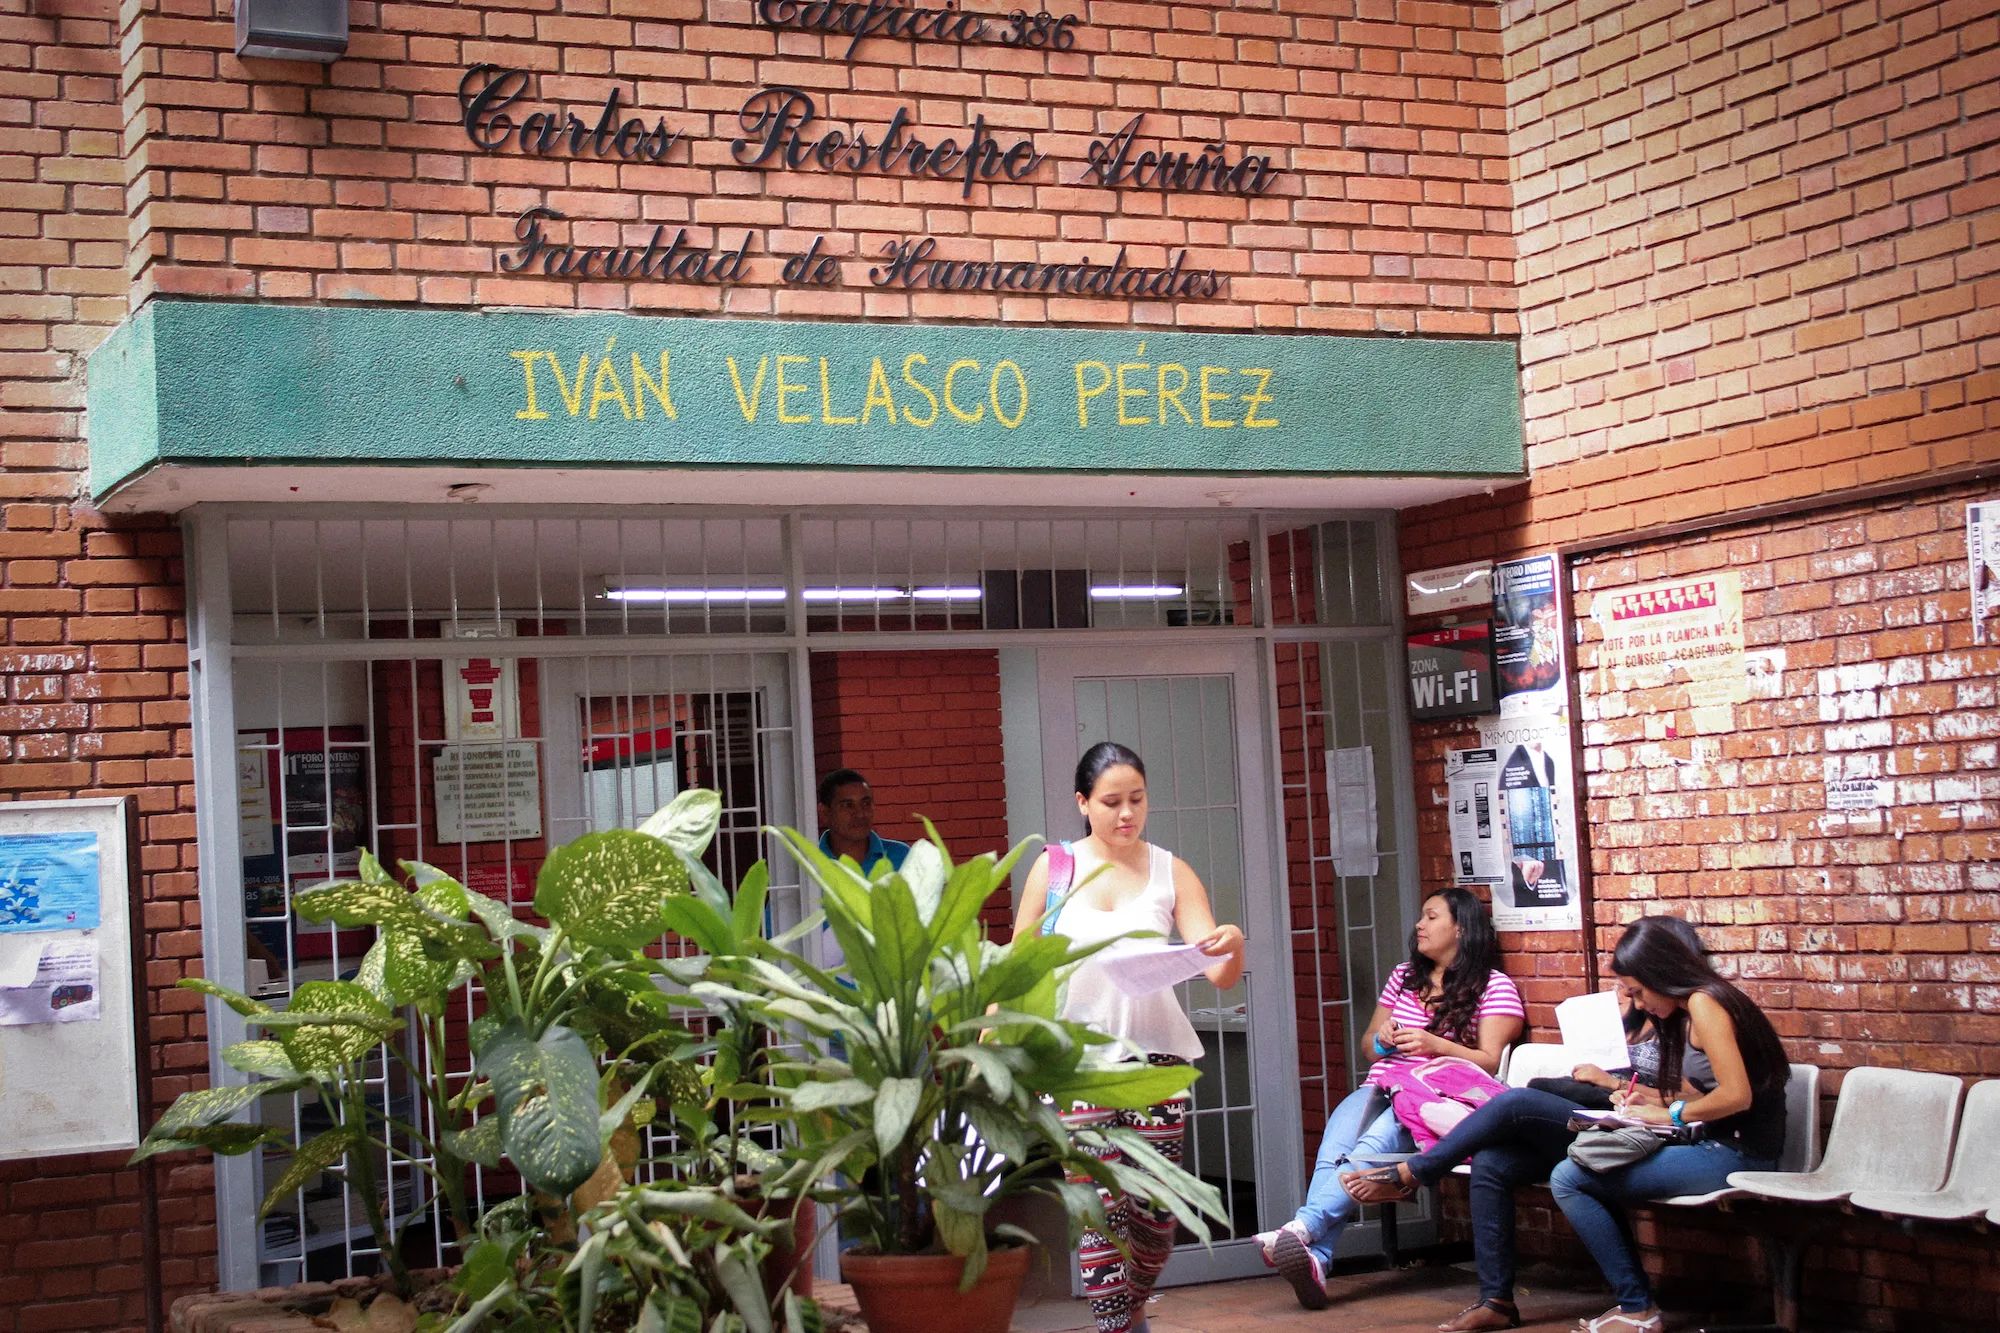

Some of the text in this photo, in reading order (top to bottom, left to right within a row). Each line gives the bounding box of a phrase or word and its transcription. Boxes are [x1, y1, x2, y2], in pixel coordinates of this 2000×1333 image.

[757, 0, 1079, 59] Edificio 386
[457, 62, 1280, 199] Carlos Restrepo Acuña
[500, 206, 1231, 300] Facultad de Humanidades
[509, 335, 1280, 431] IVÁN VELASCO PÉREZ
[1507, 564, 1524, 578] FORO
[1628, 635, 1646, 648] POR
[1650, 633, 1662, 646] LA
[1666, 626, 1709, 644] PLANCHA
[1732, 622, 1738, 634] 2
[1411, 658, 1438, 674] ZONA
[1625, 651, 1667, 668] CONSEJO
[1411, 669, 1479, 709] Wi-Fi
[301, 752, 324, 763] FORO
[328, 752, 360, 762] NTERNO
